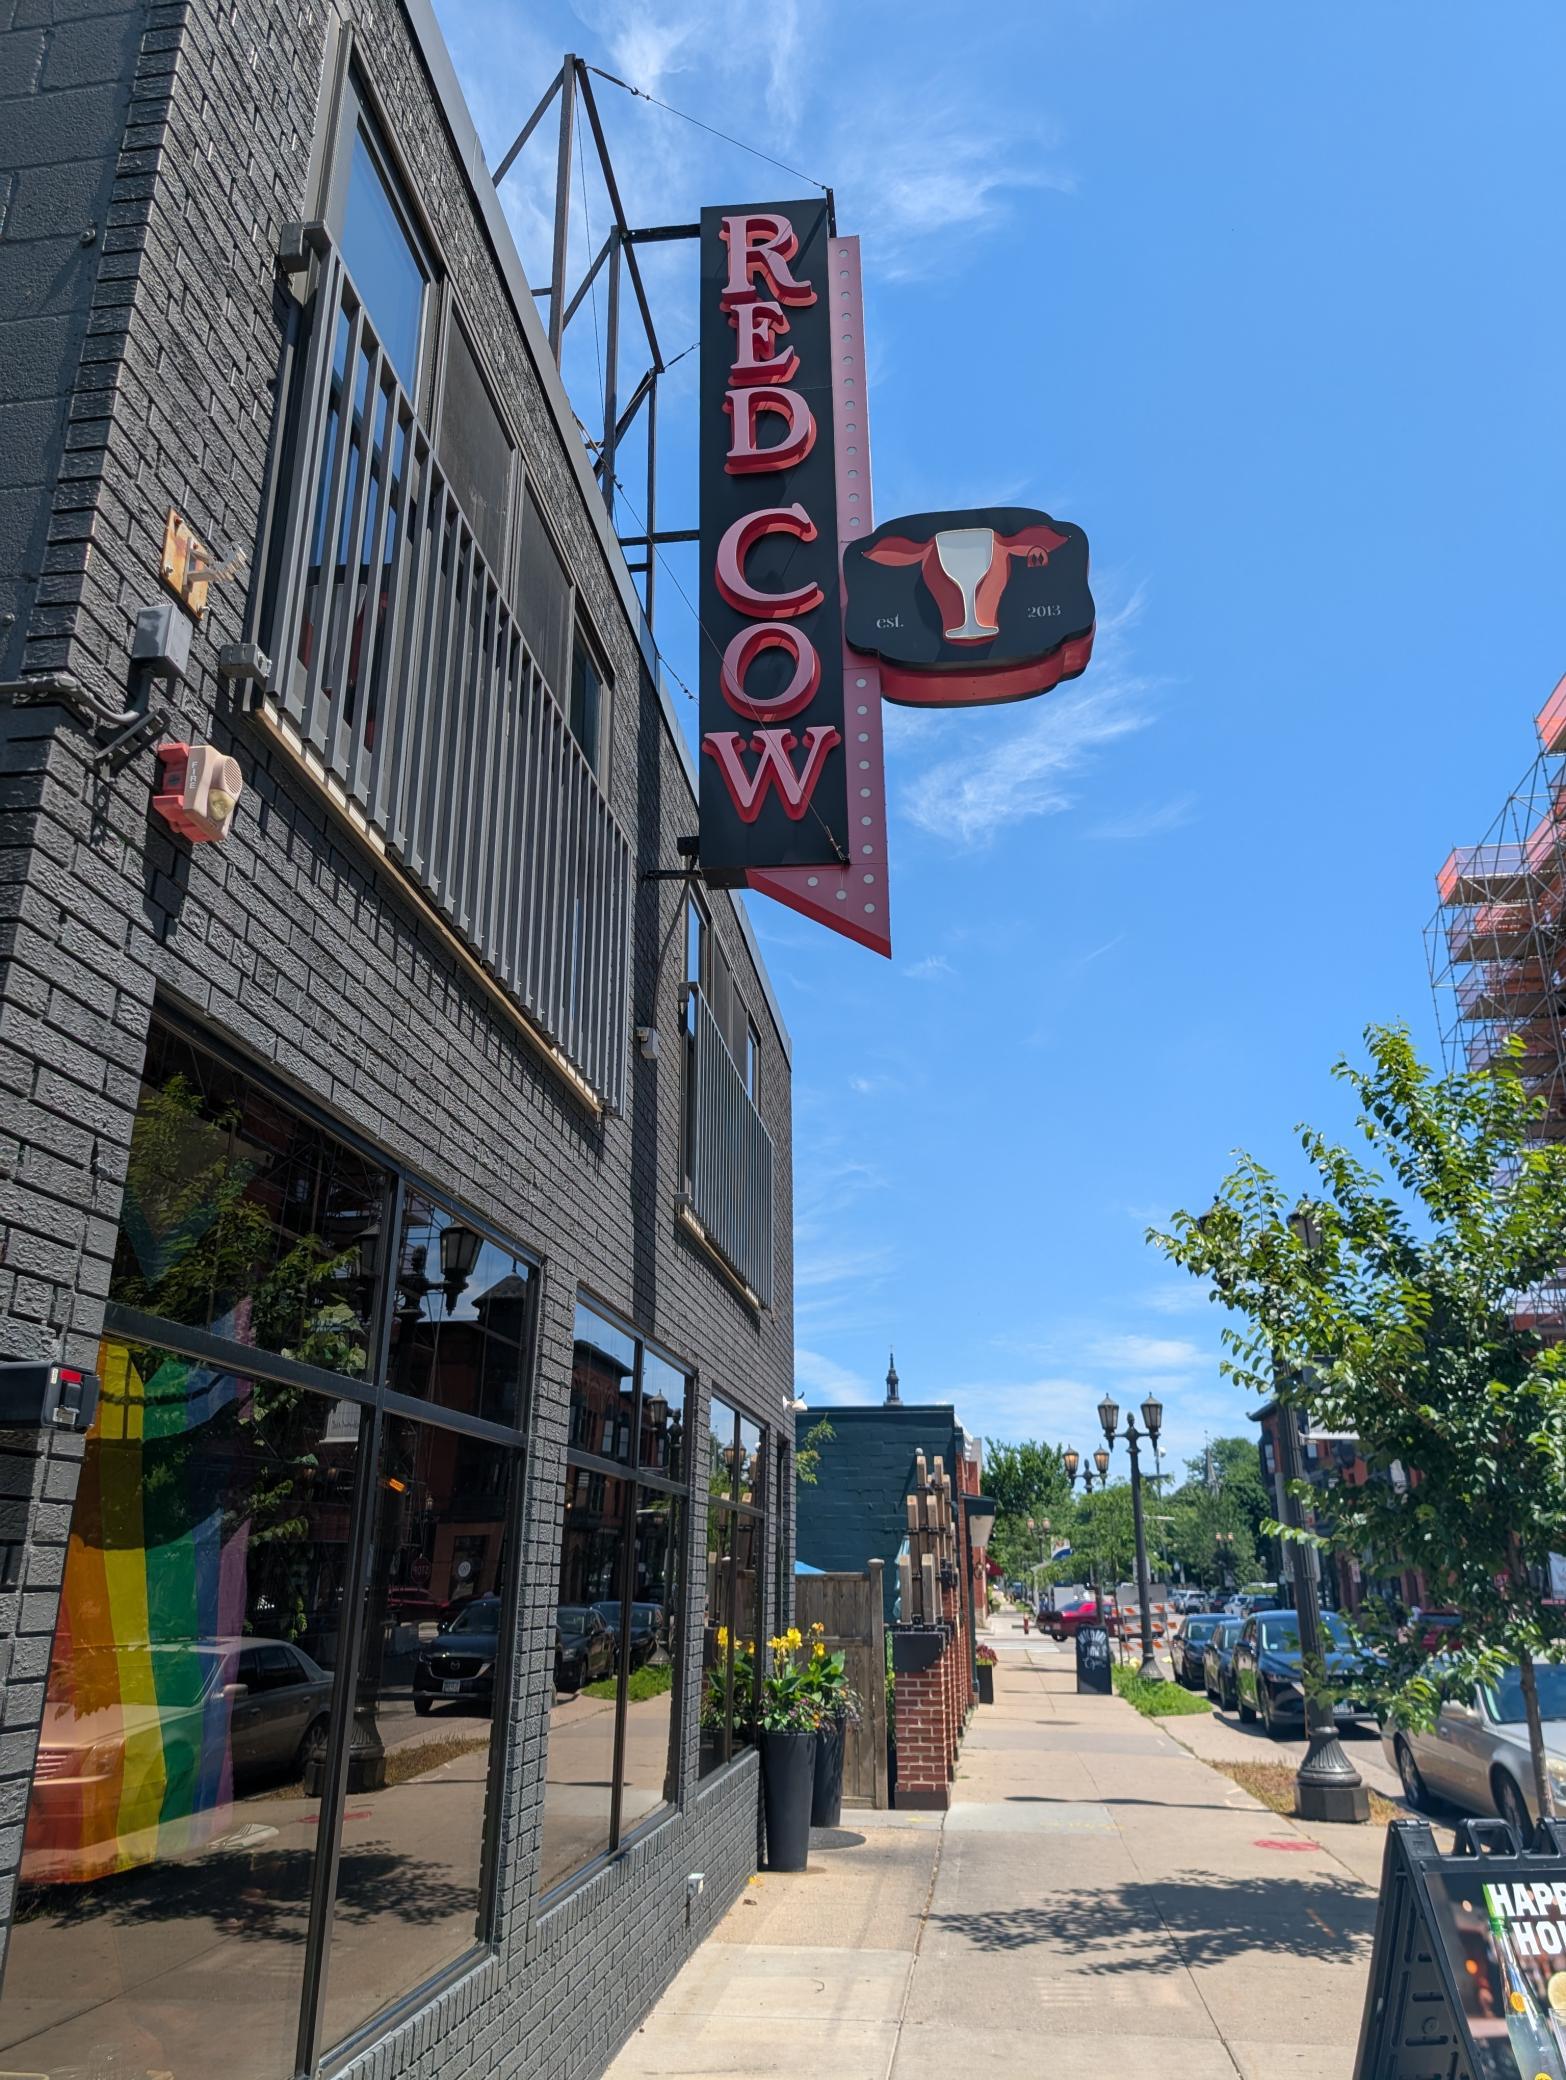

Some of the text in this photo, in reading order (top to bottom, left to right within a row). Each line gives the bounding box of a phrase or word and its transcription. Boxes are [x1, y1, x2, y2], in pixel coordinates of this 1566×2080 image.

[719, 214, 817, 475] RED
[702, 503, 841, 823] COW
[1027, 604, 1061, 618] 2013
[189, 761, 198, 789] FIRE
